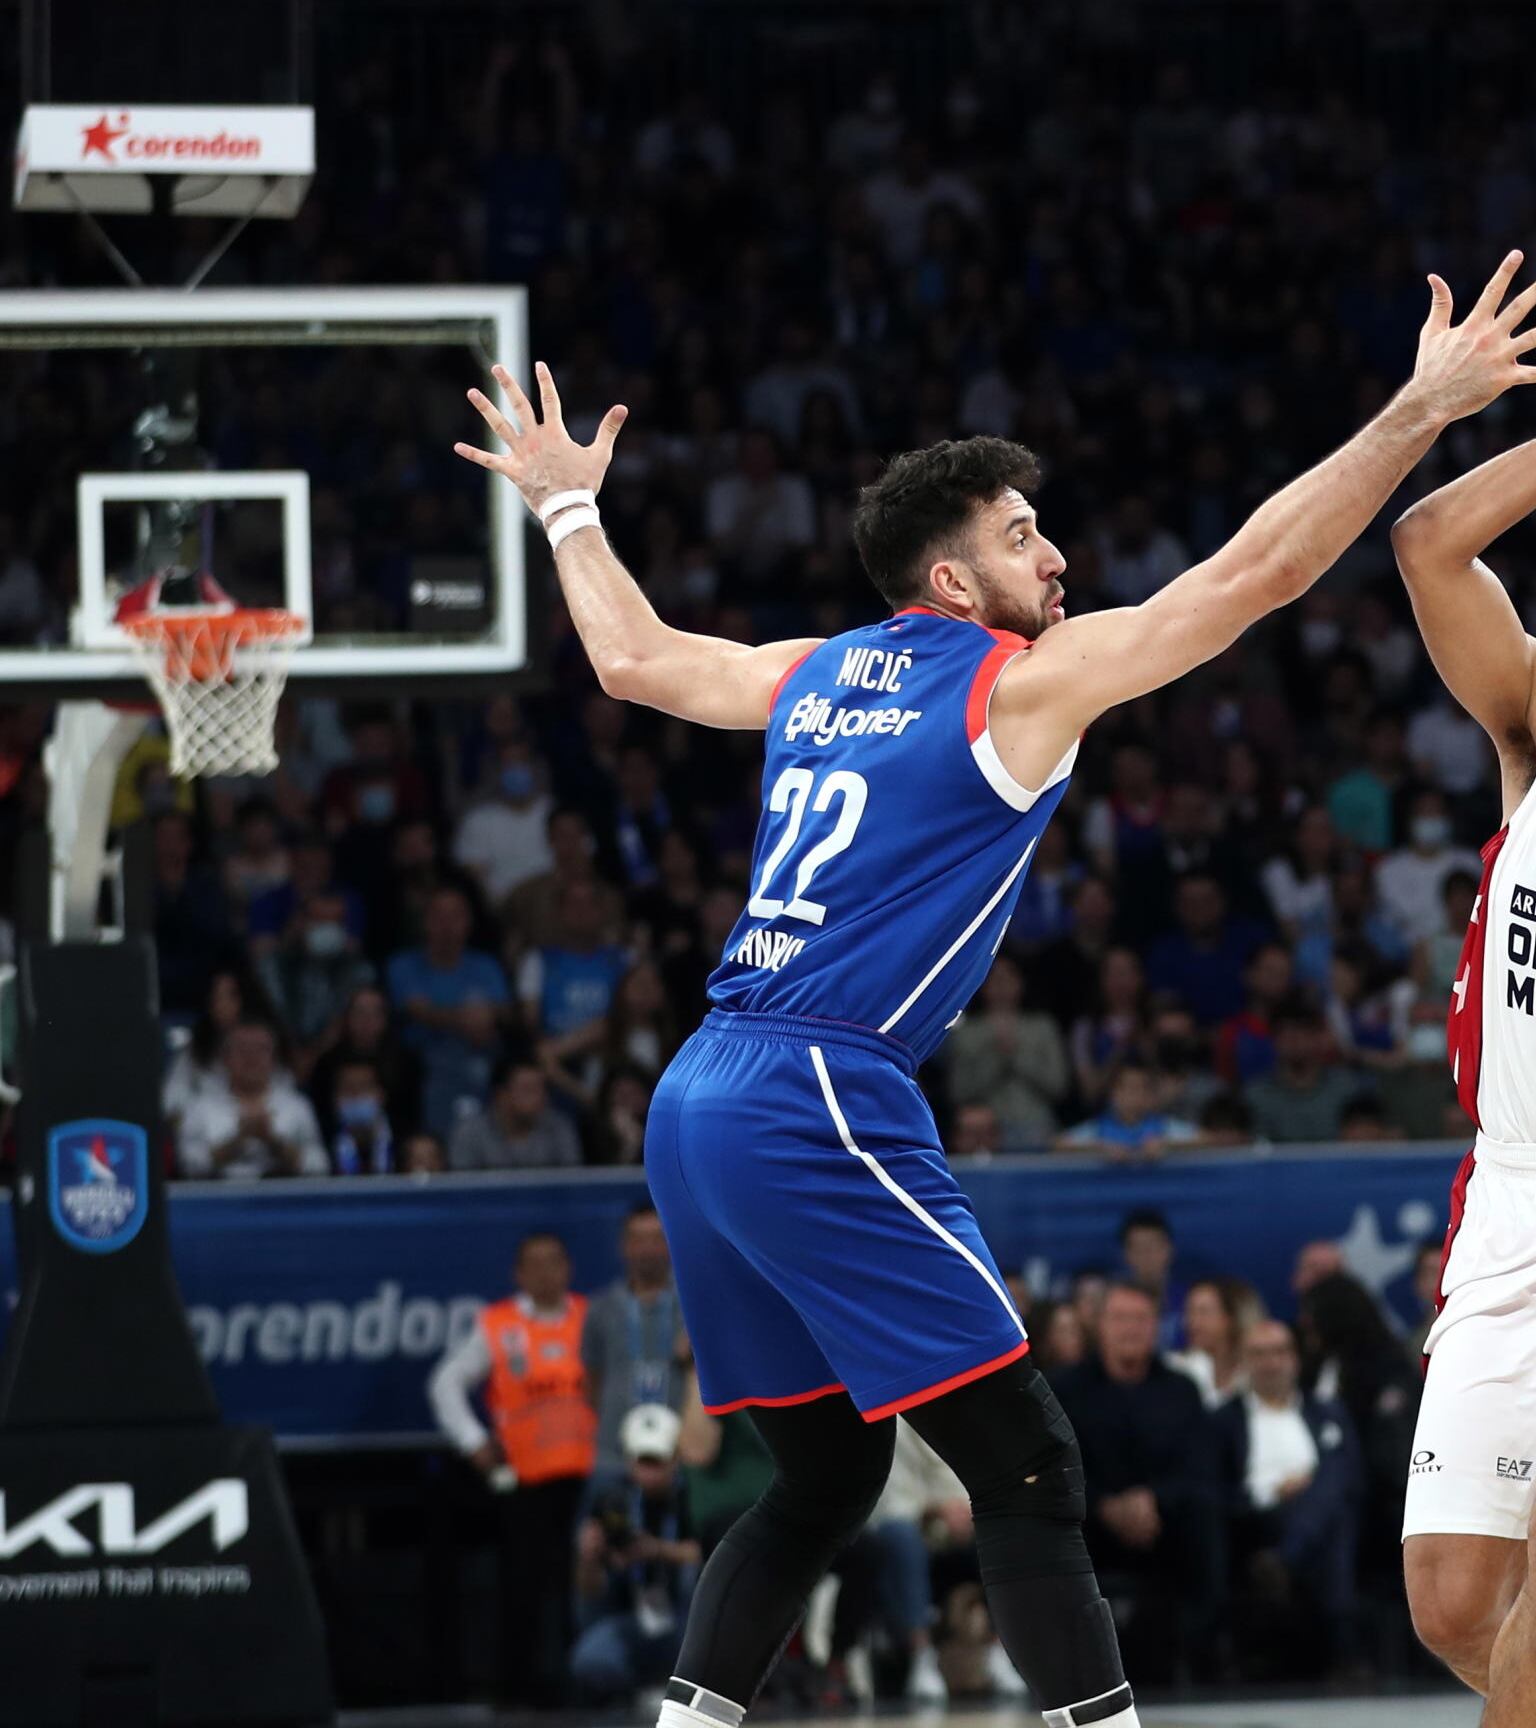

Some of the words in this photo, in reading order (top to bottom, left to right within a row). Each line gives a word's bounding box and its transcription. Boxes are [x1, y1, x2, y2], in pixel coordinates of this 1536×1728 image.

[125, 128, 261, 159] corendon
[835, 648, 913, 693] MICIĆ
[784, 692, 922, 747] Bilyoner
[748, 767, 868, 926] 22
[187, 1281, 481, 1364] orendon
[1496, 1456, 1533, 1476] EA7
[0, 1571, 100, 1602] ovement
